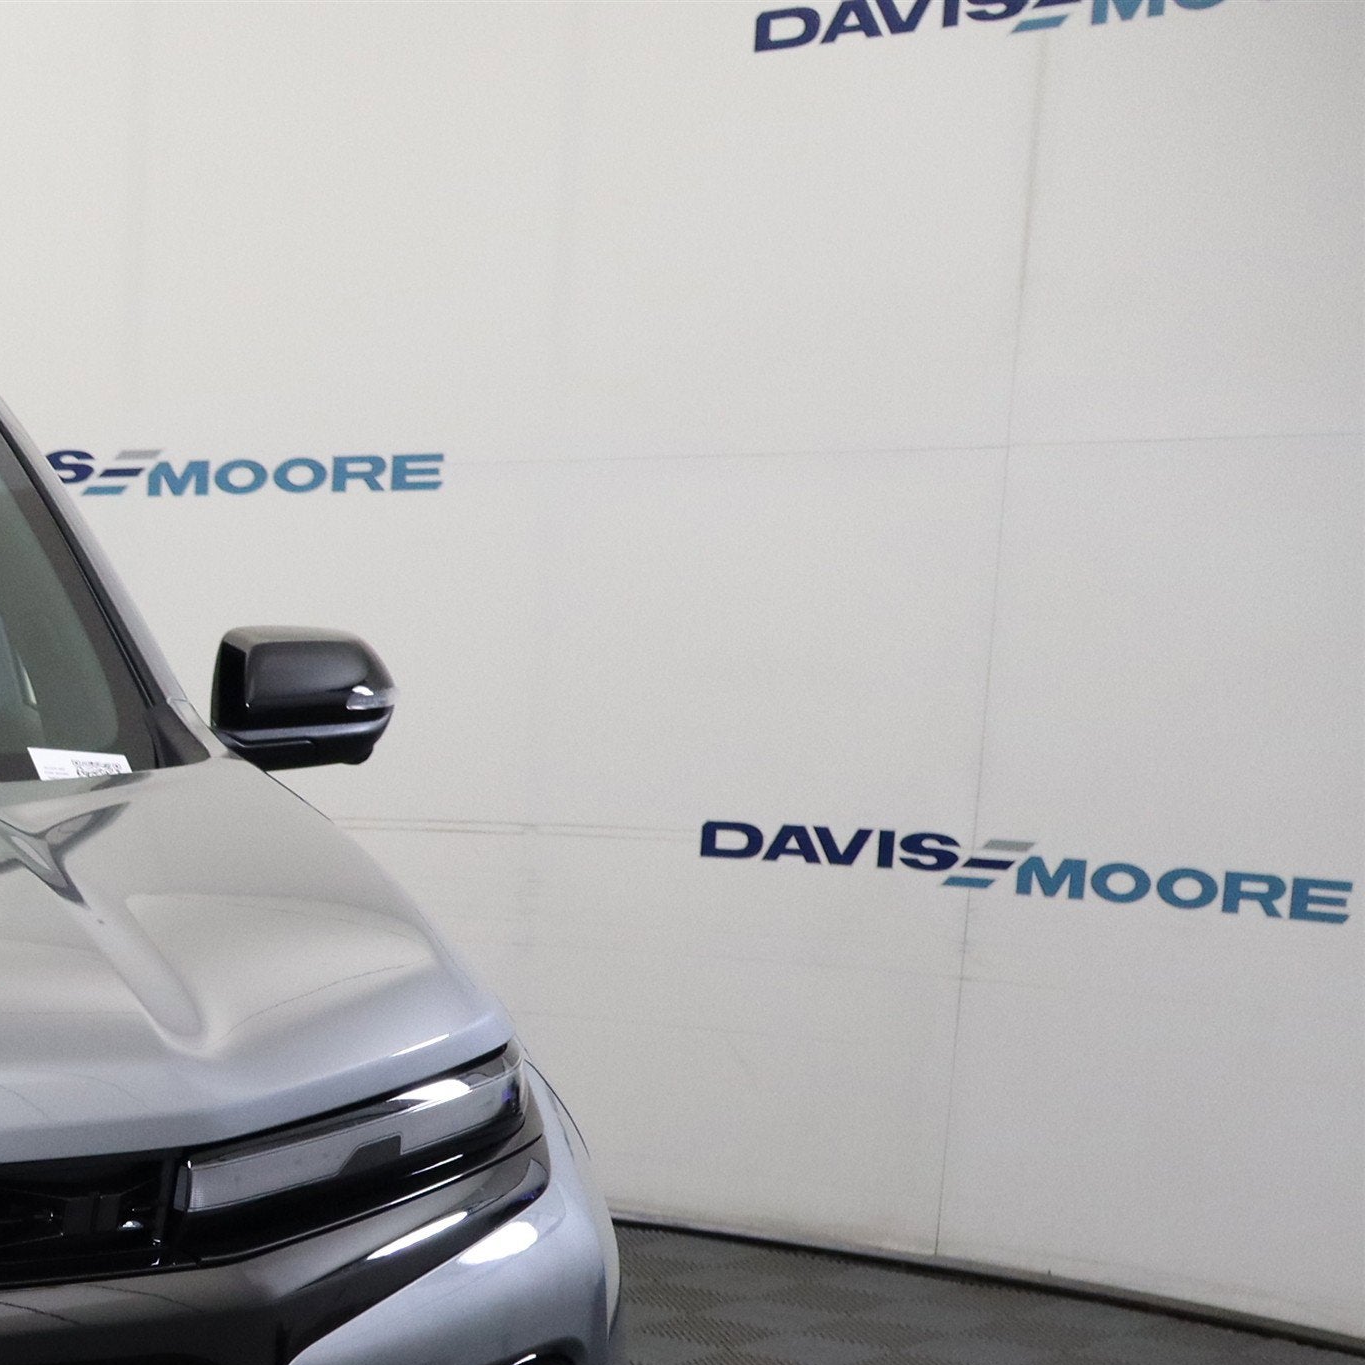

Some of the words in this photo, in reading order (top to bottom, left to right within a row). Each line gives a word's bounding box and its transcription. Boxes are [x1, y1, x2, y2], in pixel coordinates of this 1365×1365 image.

[146, 452, 445, 498] MOORE
[699, 820, 961, 872] DAVIS
[1015, 854, 1354, 925] MOORE
